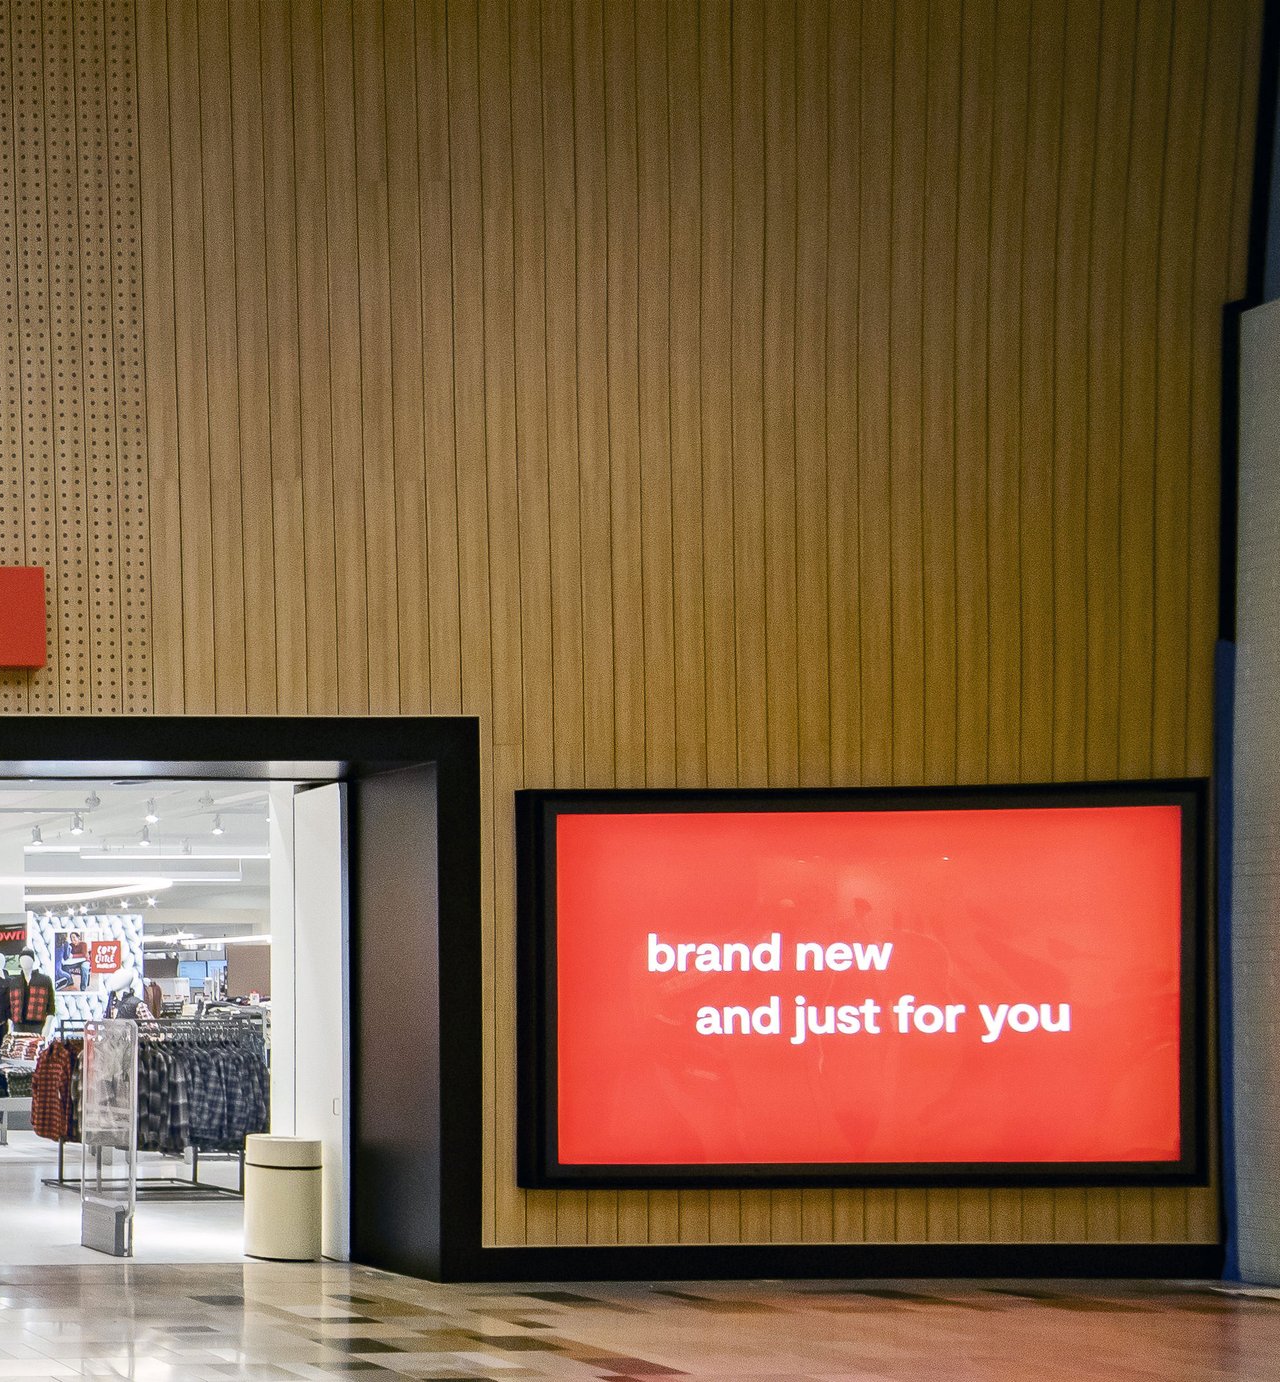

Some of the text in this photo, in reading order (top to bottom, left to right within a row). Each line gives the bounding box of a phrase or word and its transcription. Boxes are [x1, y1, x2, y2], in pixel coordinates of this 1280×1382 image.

[647, 932, 894, 973] brand new
[695, 994, 1072, 1045] and just for you
